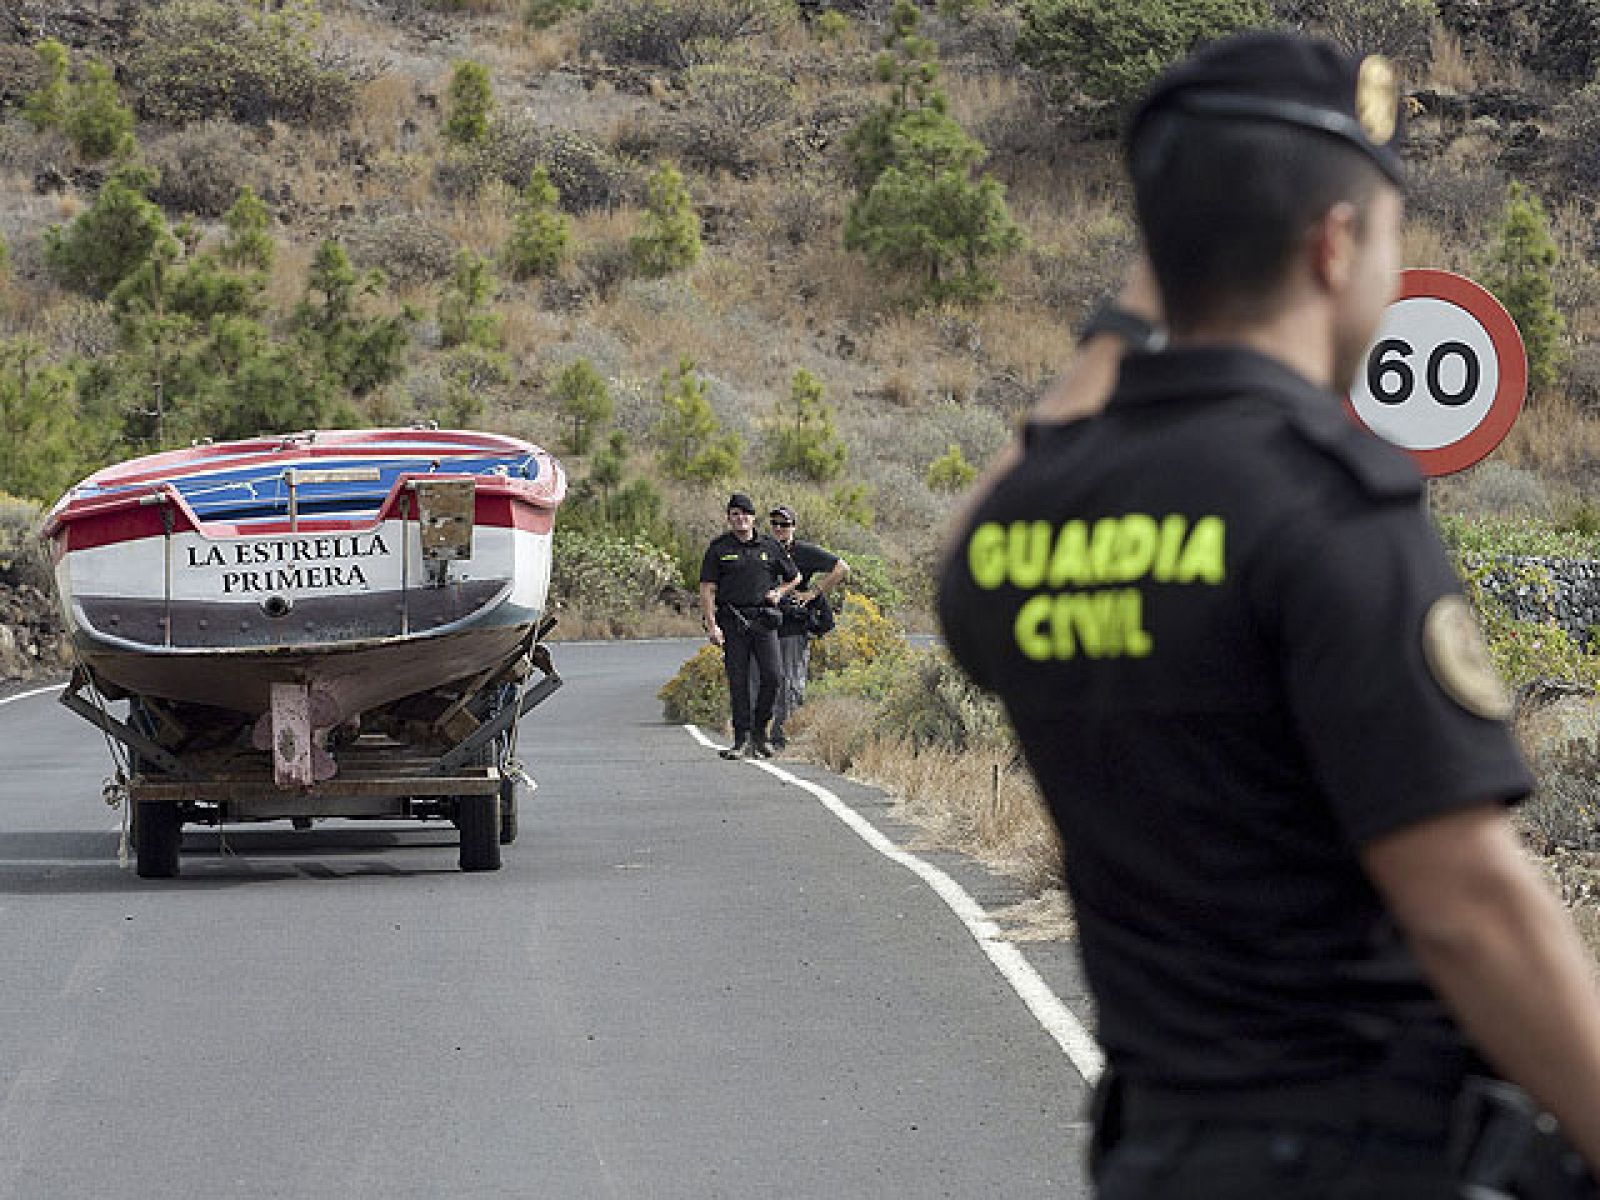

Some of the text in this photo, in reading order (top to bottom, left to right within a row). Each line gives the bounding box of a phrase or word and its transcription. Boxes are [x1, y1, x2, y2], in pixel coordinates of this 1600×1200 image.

[1367, 339, 1481, 407] 60
[187, 534, 391, 568] LA ESTRELLA
[222, 564, 370, 594] PRIMERA
[968, 513, 1226, 590] GUARDIA
[1014, 587, 1153, 661] CIVIL
